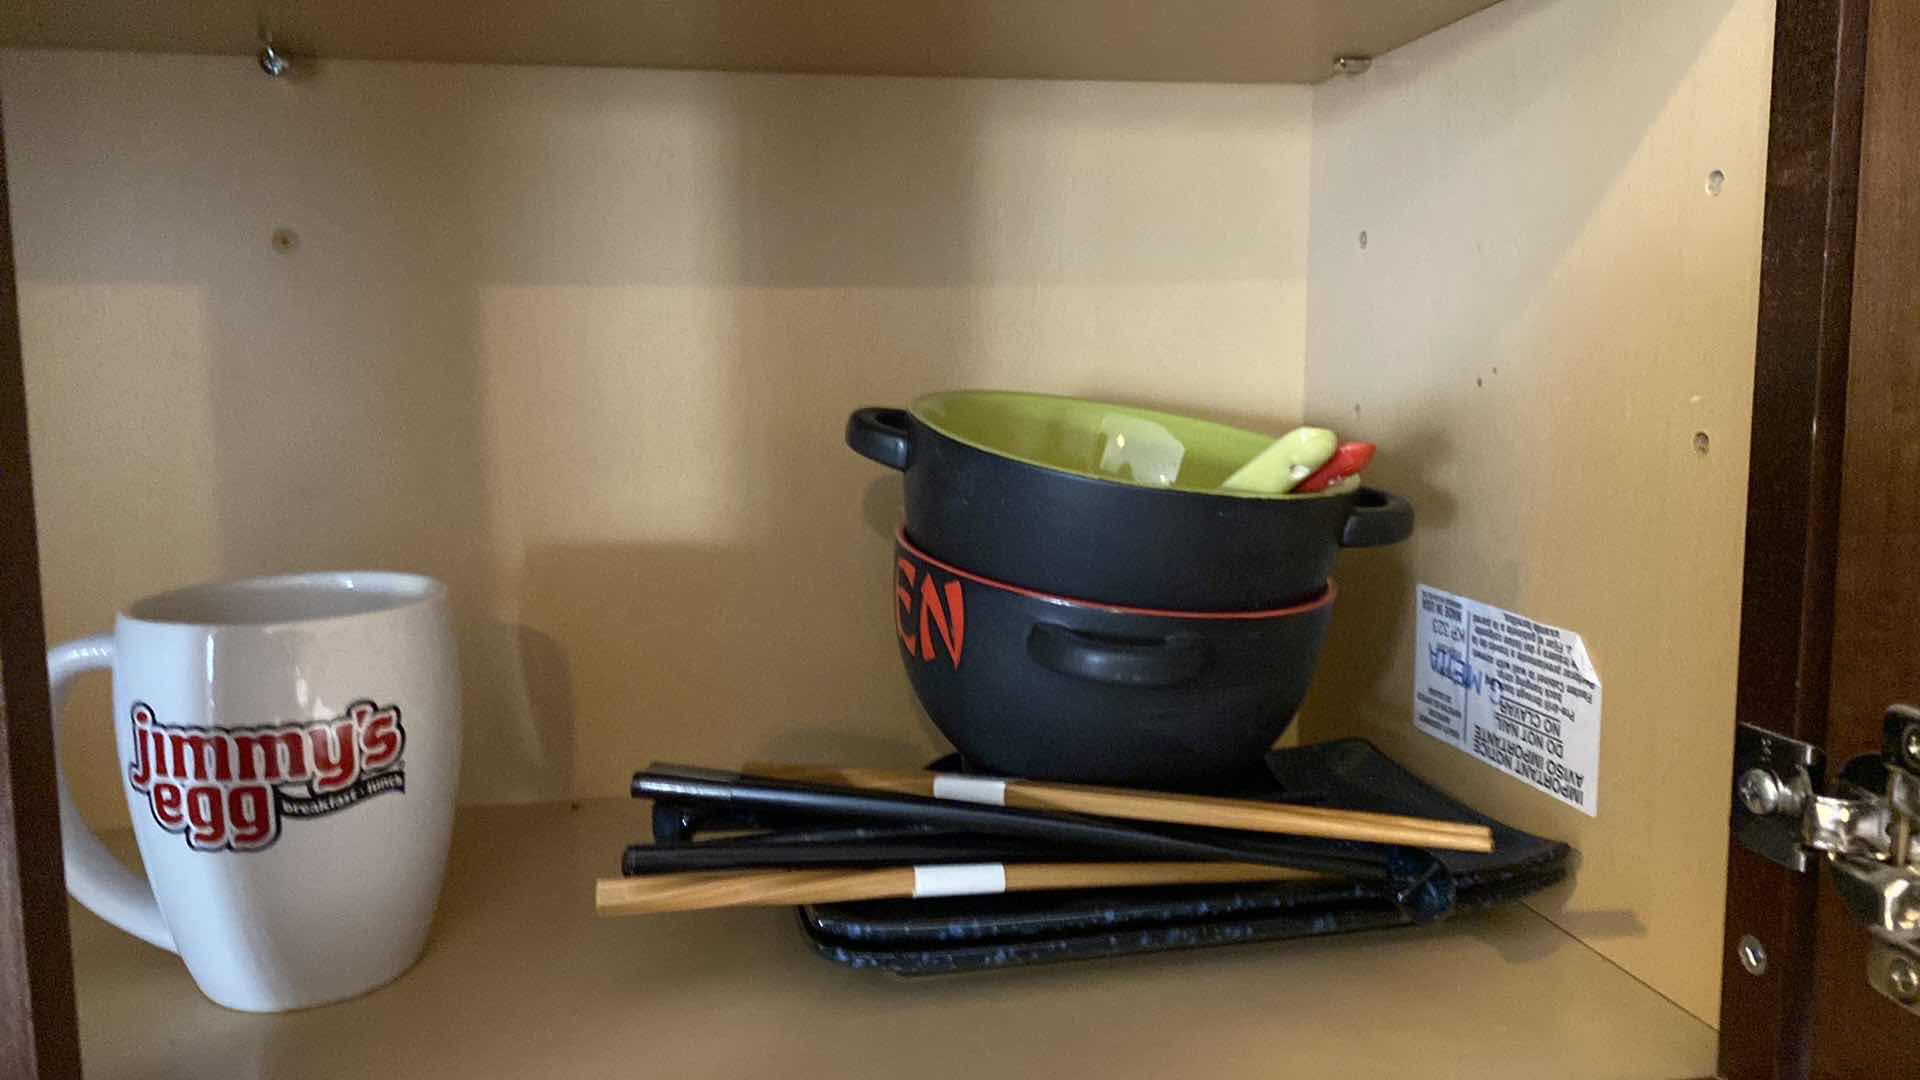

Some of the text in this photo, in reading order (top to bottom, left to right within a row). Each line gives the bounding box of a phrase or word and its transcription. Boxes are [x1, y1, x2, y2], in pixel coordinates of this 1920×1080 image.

[1495, 715, 1563, 759] DO NOT NAIL
[1499, 698, 1560, 738] NO CLAVAR
[131, 705, 402, 791] jimmy's
[1474, 724, 1543, 770] IMPORTANTE
[1473, 738, 1583, 805] IMPORTANT NOTICE
[1546, 758, 1584, 790] AVISO
[153, 783, 271, 843] egg
